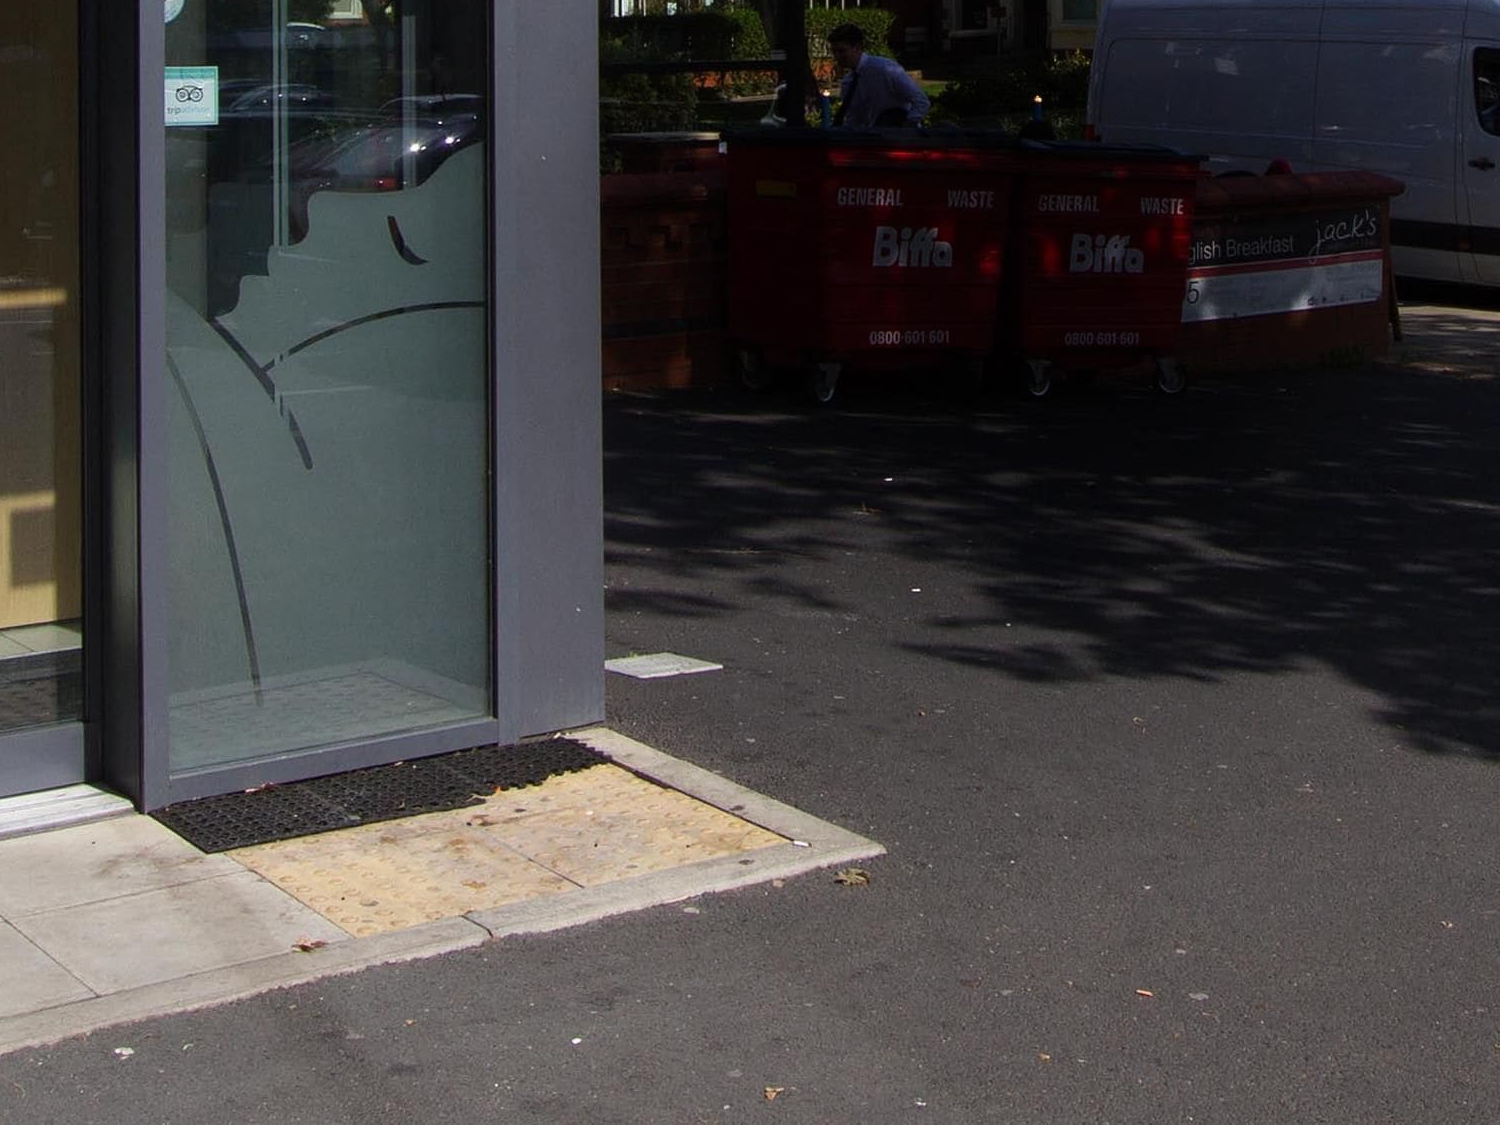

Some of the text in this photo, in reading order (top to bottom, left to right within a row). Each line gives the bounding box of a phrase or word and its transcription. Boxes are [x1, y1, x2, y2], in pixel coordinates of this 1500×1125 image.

[837, 187, 995, 208] GENERAL WASTE
[1038, 195, 1184, 215] GENERAL WASTE
[871, 226, 953, 268] Biffa
[1226, 235, 1294, 259] Breakfast
[1308, 209, 1377, 264] jack's
[1069, 233, 1145, 273] Biffa
[869, 331, 900, 346] 0800
